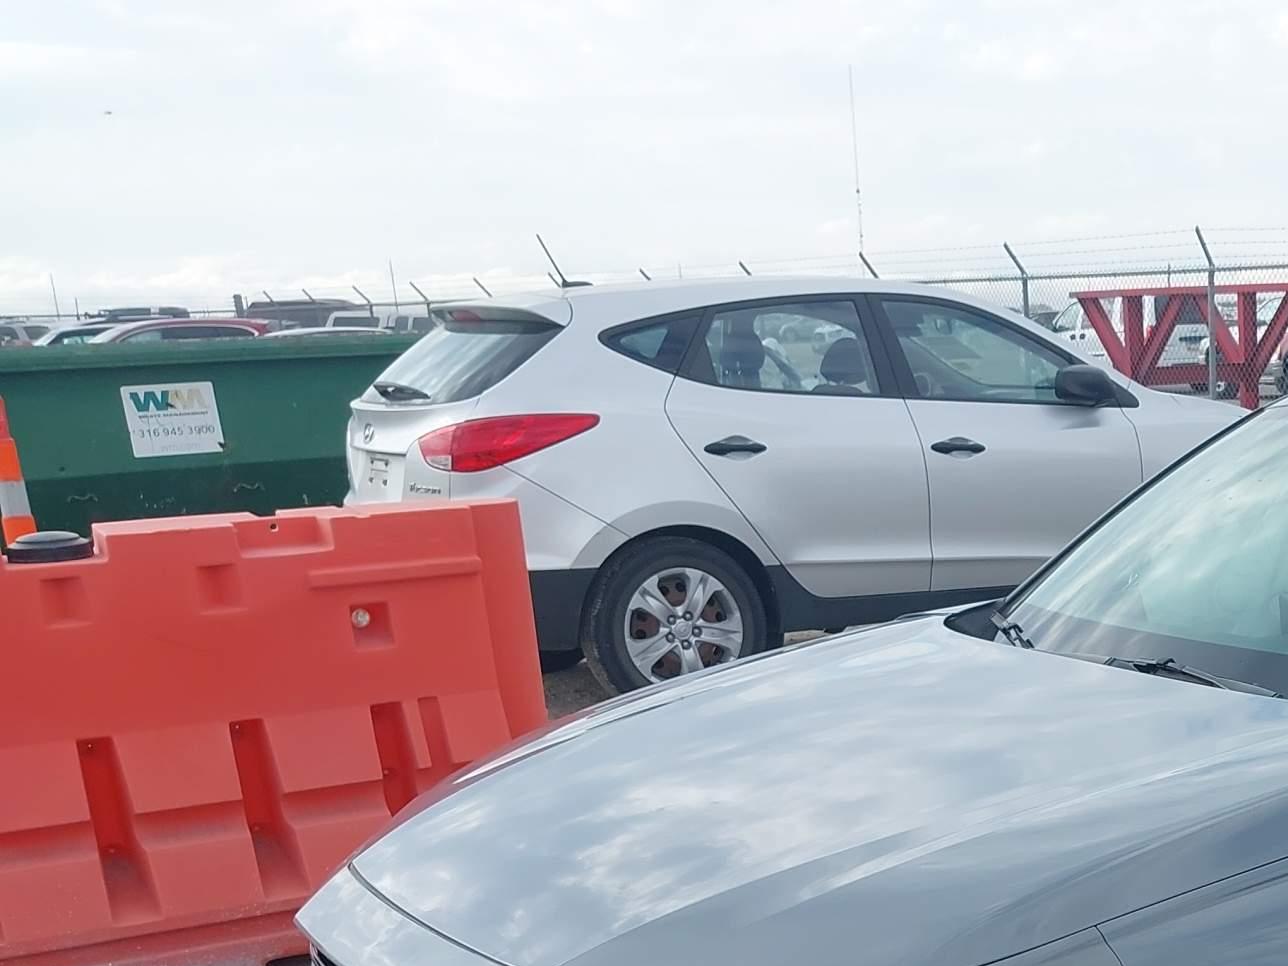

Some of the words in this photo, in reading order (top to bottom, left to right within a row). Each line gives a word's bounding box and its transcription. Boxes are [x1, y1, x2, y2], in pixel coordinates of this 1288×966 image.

[129, 388, 208, 412] WM
[139, 427, 160, 438] 316
[162, 424, 184, 436] 945
[187, 424, 215, 434] 3900
